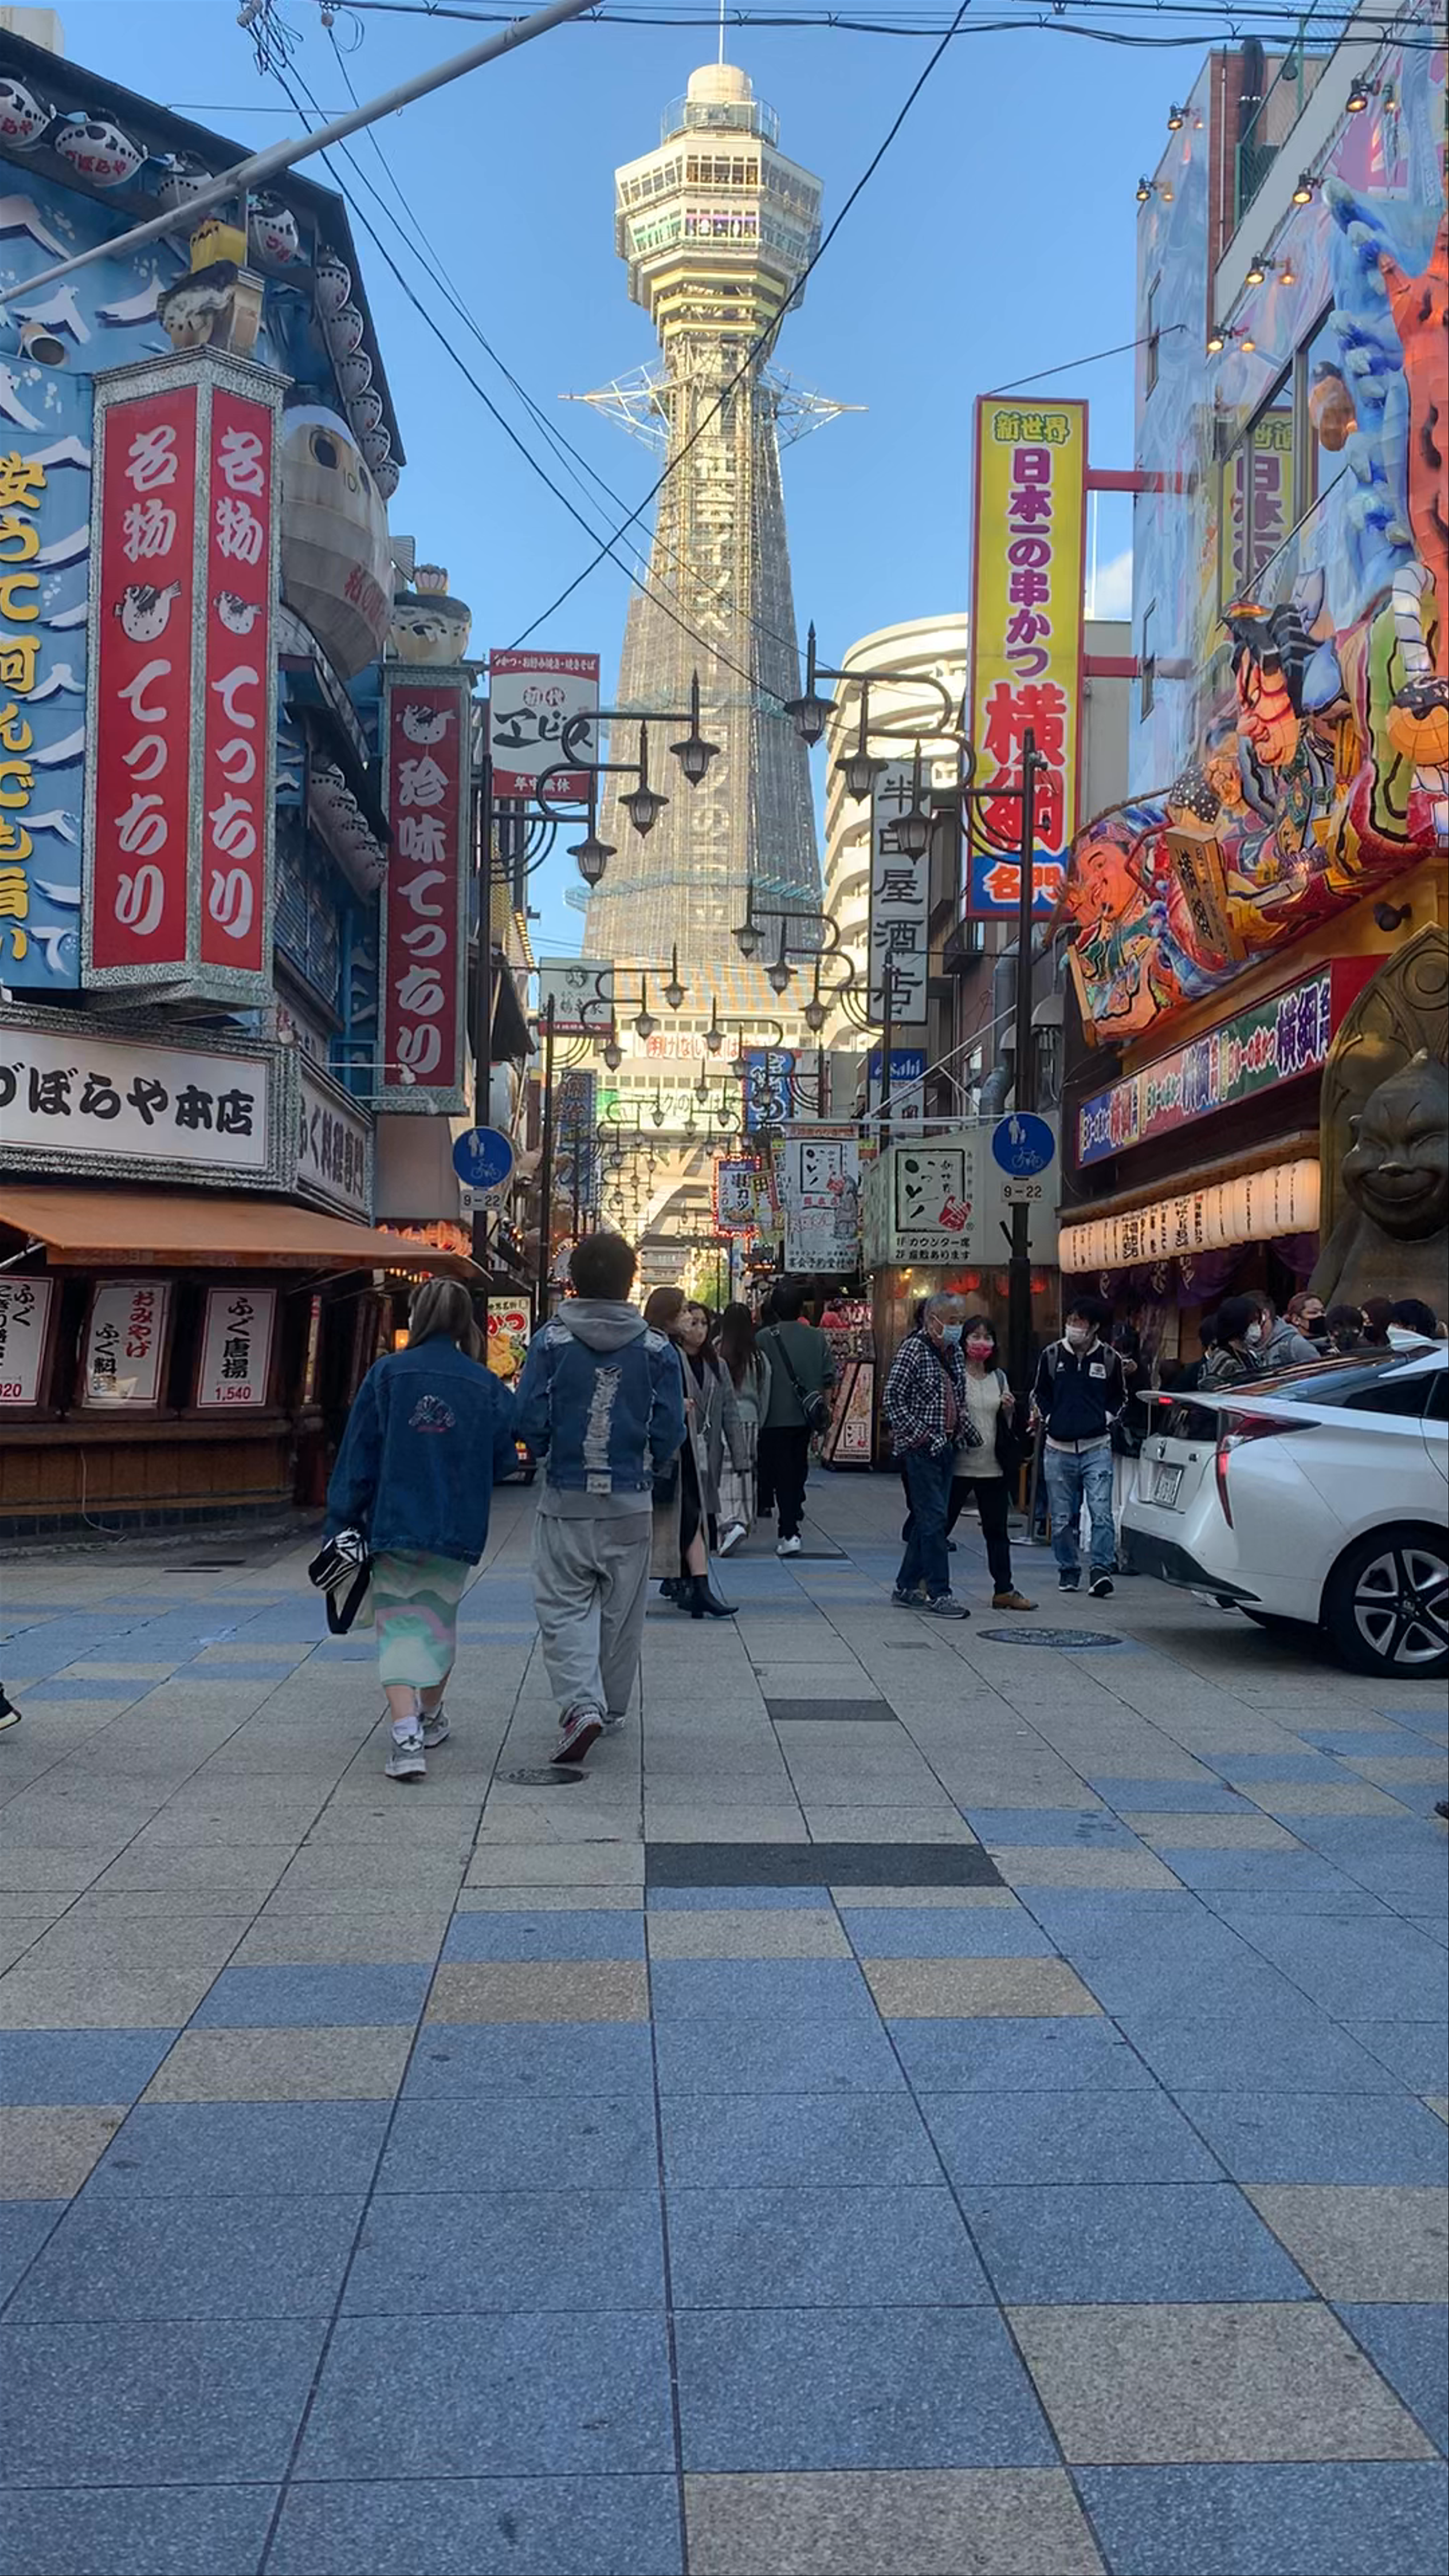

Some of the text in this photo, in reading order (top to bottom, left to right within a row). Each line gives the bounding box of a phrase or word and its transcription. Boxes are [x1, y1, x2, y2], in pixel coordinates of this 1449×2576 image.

[995, 412, 1070, 444] 新世界
[1006, 448, 1051, 678] 日本一の串かつ
[114, 423, 177, 936] 名物 てっちり
[208, 426, 264, 939] 名物 てっちり
[983, 681, 1066, 853] 横綱
[394, 754, 448, 1077] 珍味てっちり
[1275, 981, 1320, 1078] 横綱
[464, 1195, 501, 1207] 9-22
[1004, 1185, 1042, 1198] 9-22
[12, 1284, 35, 1327] ふぐ
[126, 1290, 154, 1358] おみやげ
[220, 1297, 254, 1379] ふぐ唐揚
[0, 1383, 22, 1397] 20
[93, 1323, 120, 1392] ふぐ料理
[215, 1386, 251, 1401] 1,540
